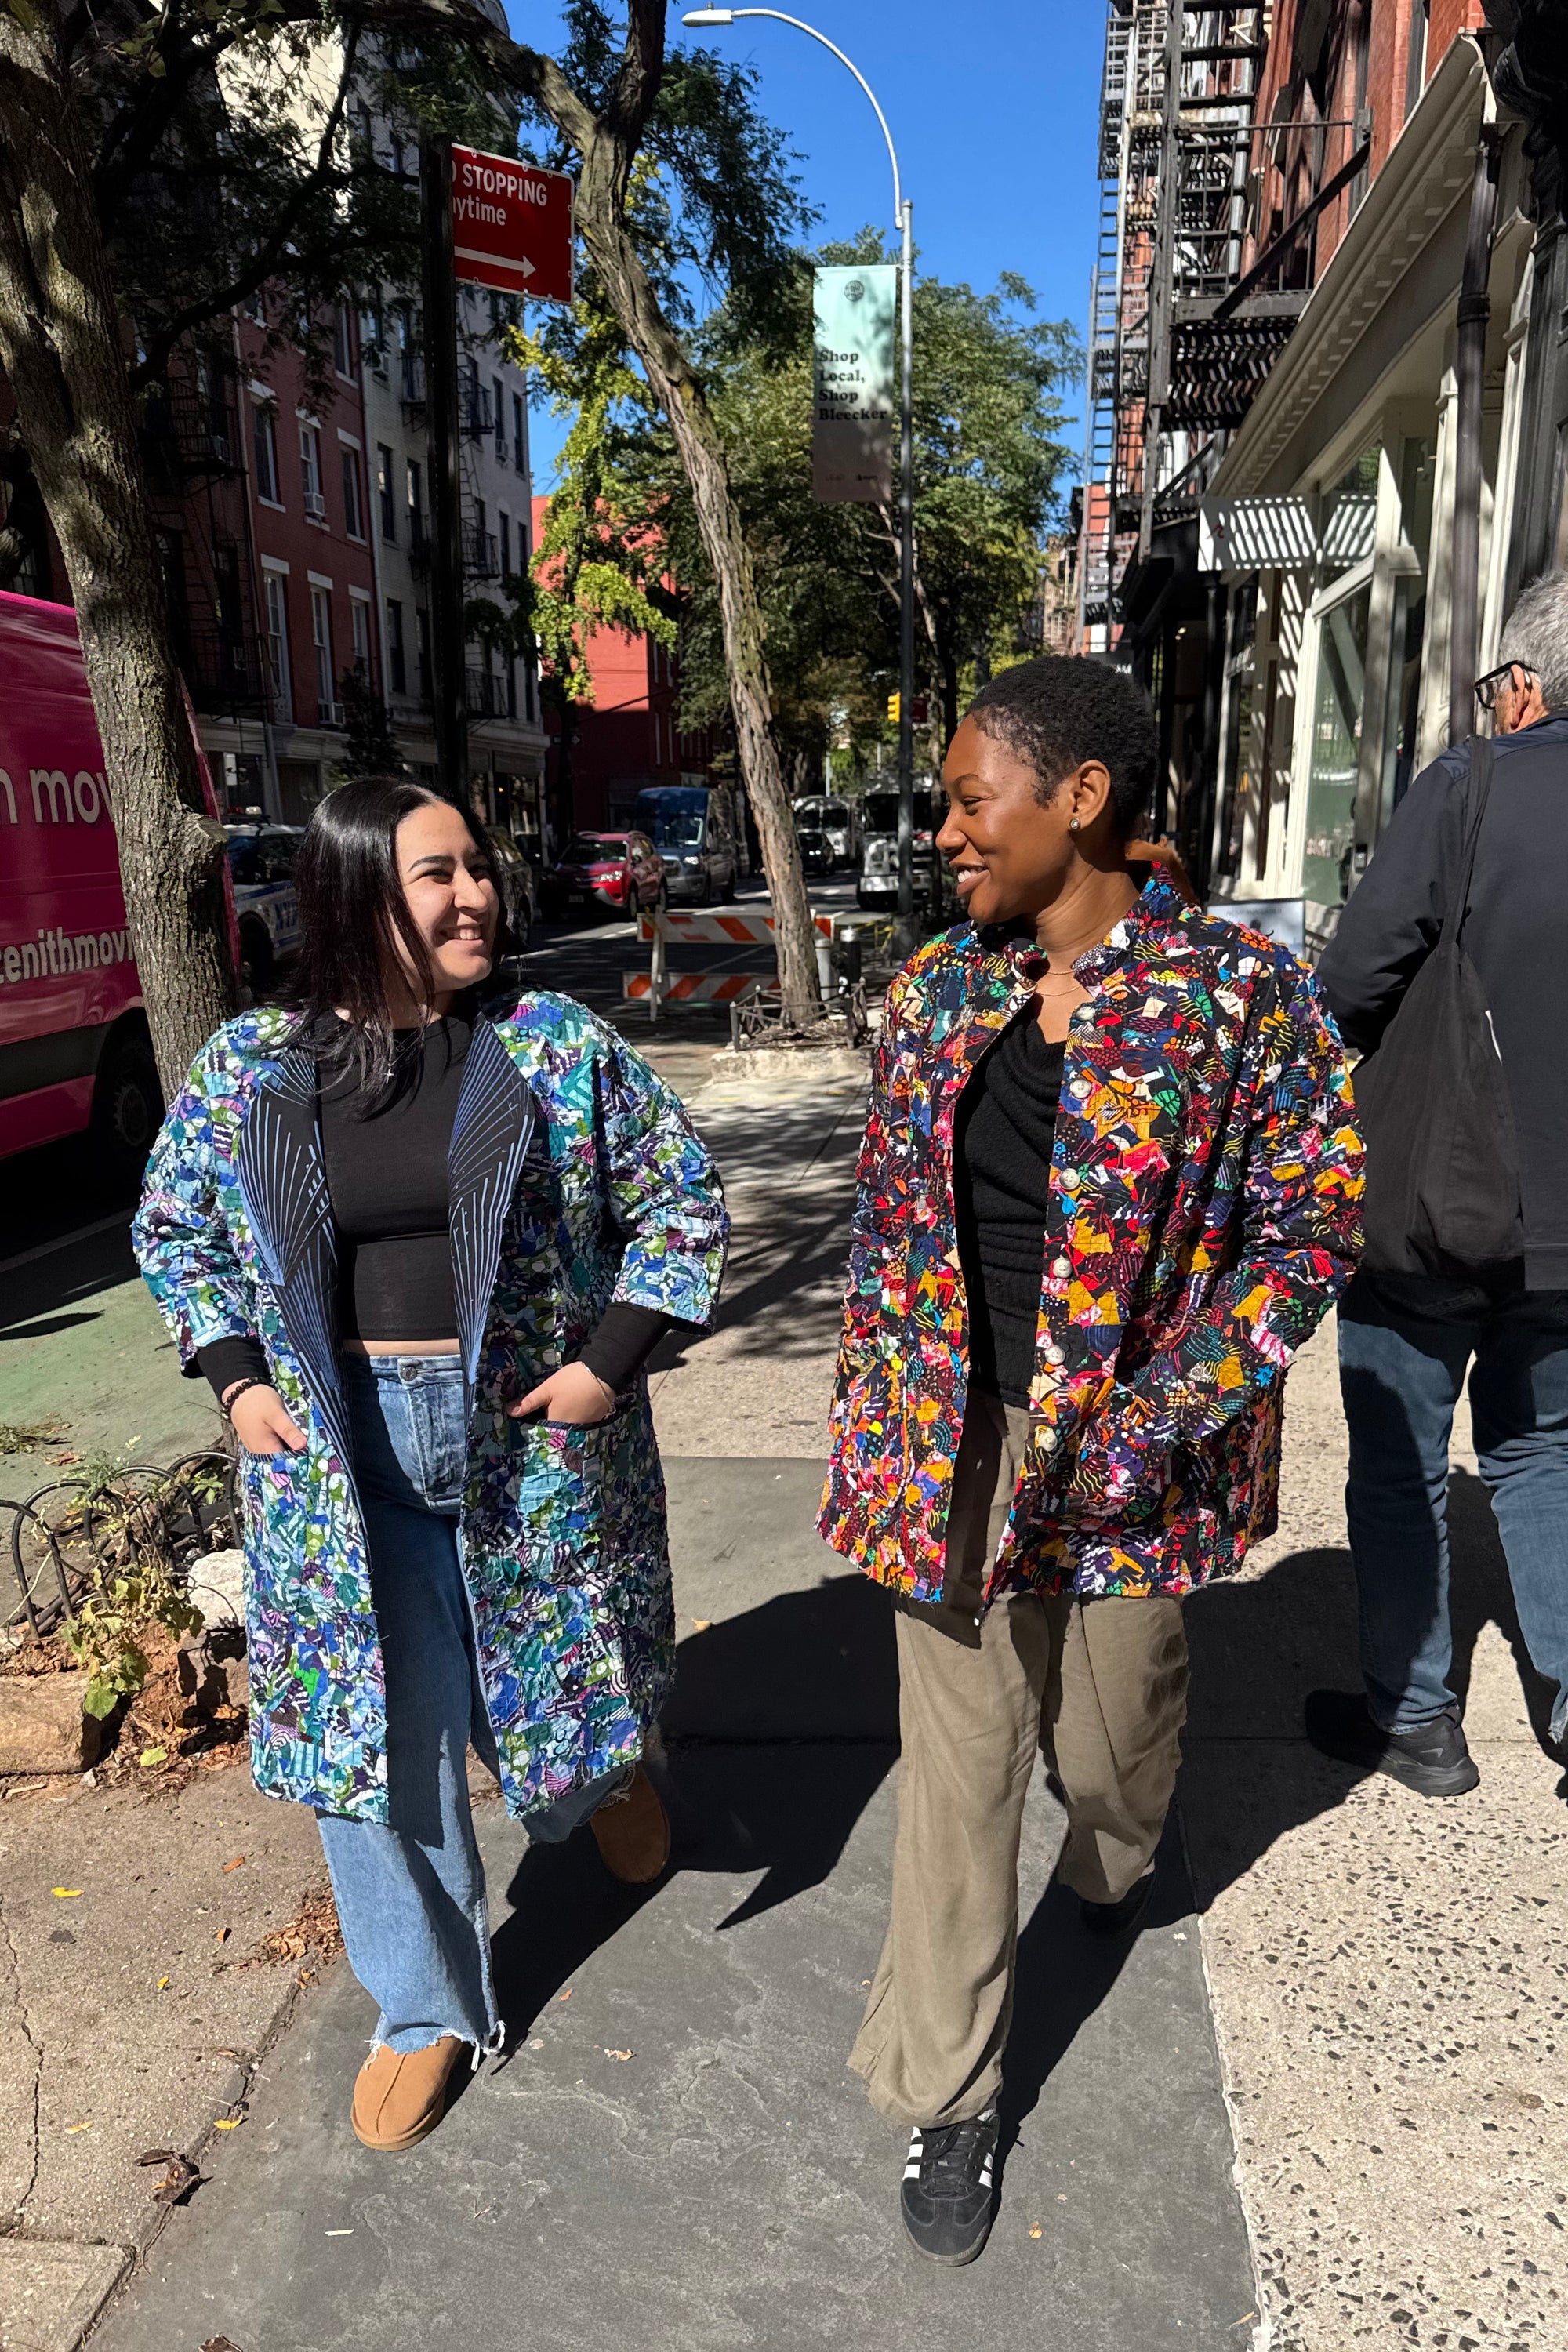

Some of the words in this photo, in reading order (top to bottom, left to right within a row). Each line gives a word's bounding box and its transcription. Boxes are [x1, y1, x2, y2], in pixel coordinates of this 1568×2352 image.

[463, 163, 547, 206] STOPPING
[818, 350, 859, 364] Shop
[820, 370, 866, 383] Local,
[818, 389, 858, 403] Shop
[818, 408, 887, 420] Bleecker
